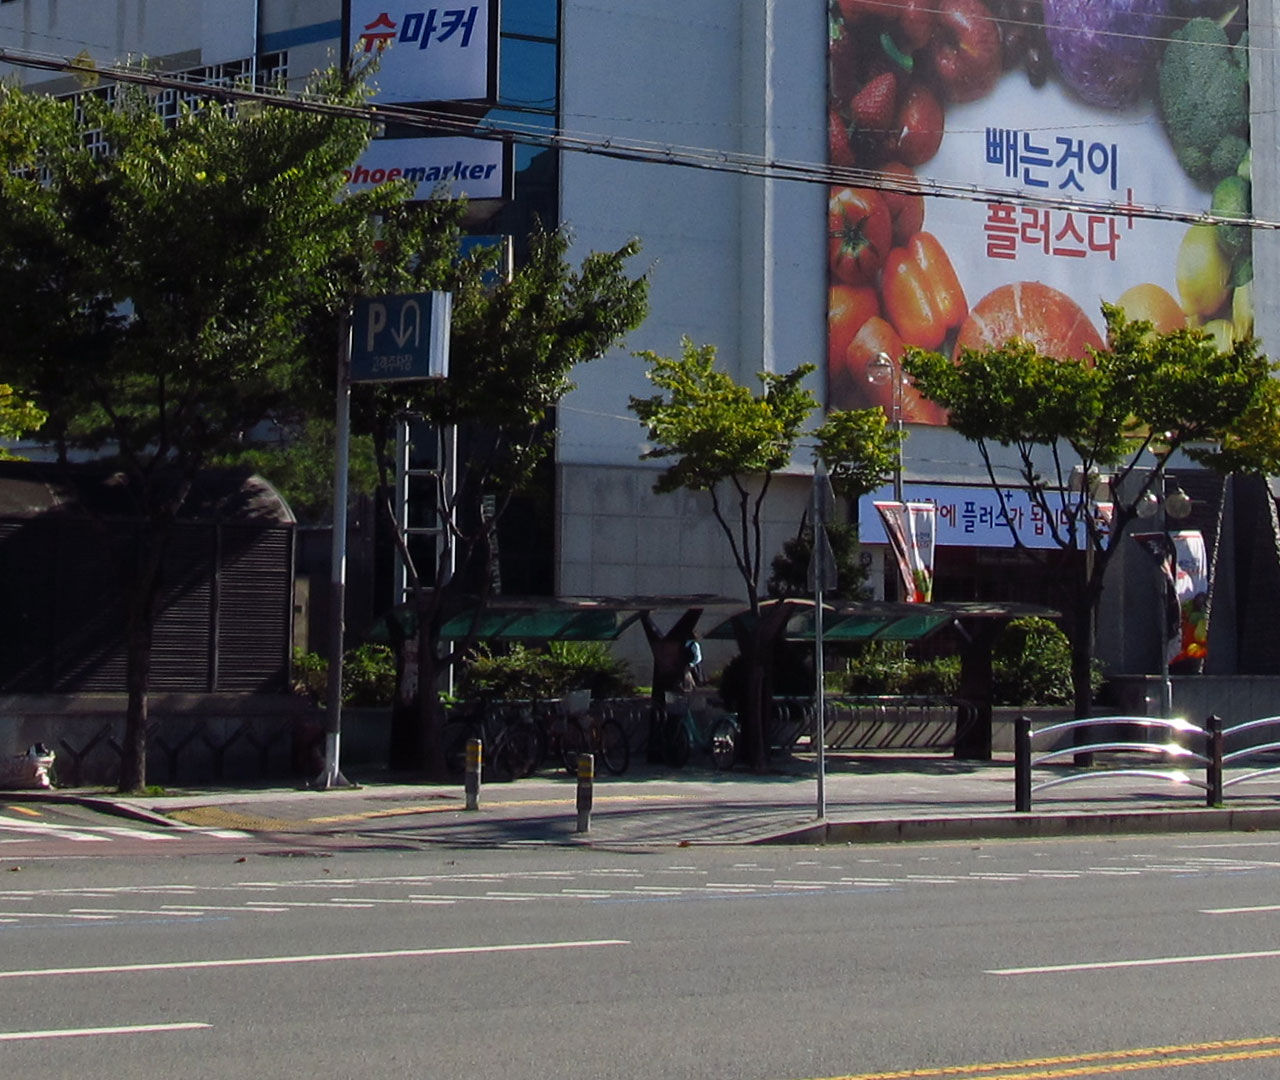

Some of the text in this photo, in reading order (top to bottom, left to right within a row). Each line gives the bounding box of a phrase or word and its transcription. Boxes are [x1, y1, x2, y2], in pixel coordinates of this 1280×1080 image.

[360, 6, 479, 52] 슈마커
[985, 126, 1118, 192] 빼는것이
[983, 202, 1121, 262] 플러스다
[367, 303, 387, 352] P
